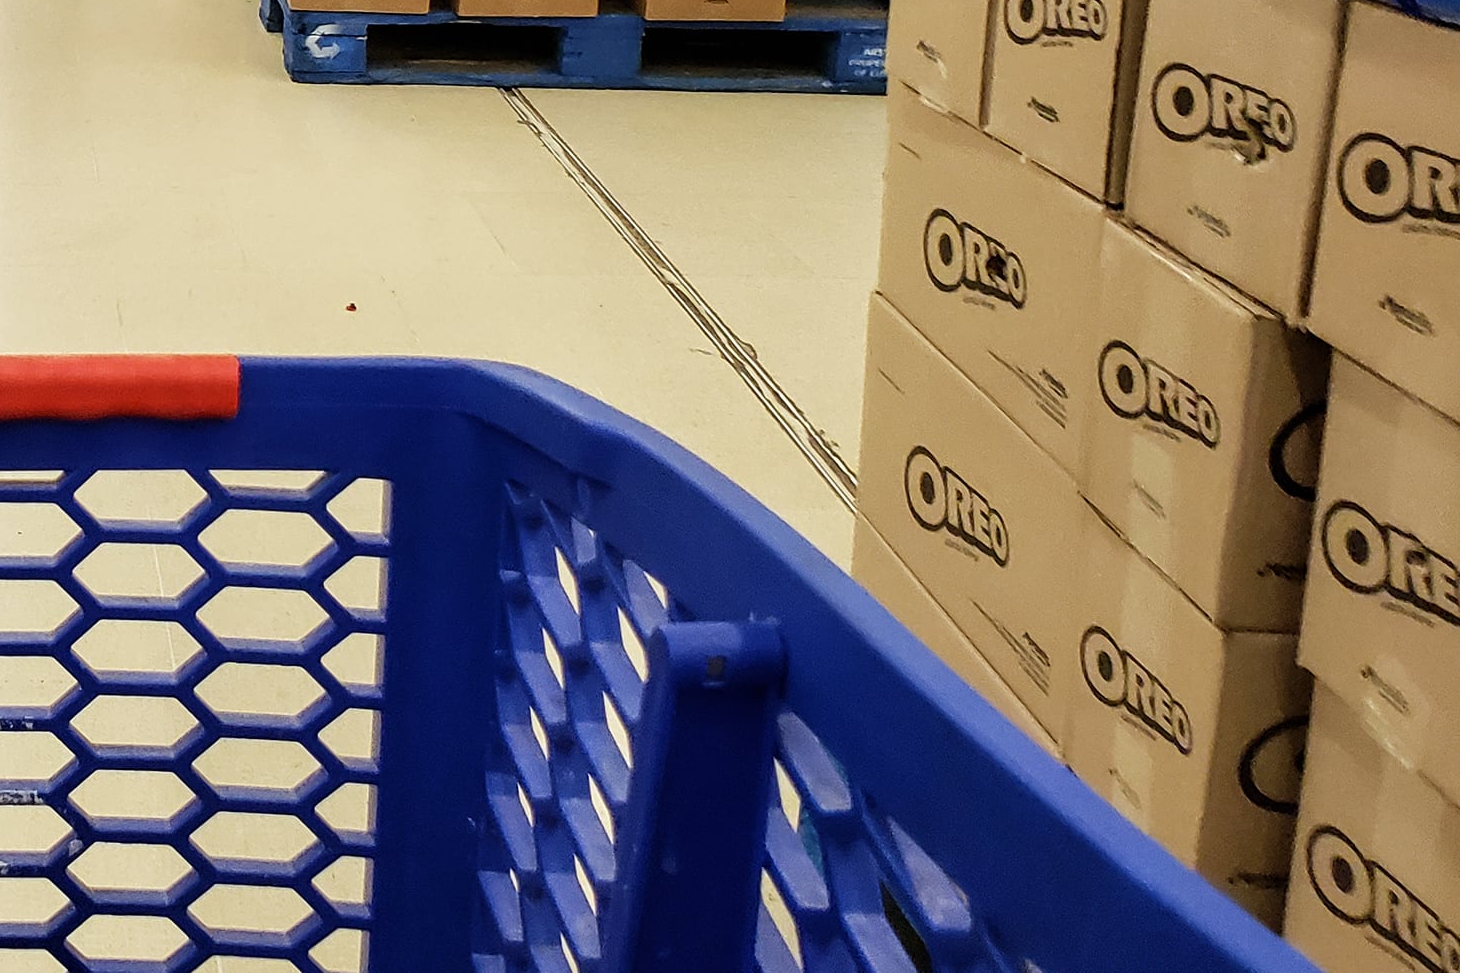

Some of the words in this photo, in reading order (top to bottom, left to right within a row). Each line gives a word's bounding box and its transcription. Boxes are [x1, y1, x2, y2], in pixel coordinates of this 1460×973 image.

[1151, 62, 1297, 152] OREO
[1097, 339, 1221, 450] OREO
[904, 444, 1010, 568] OREO
[1080, 625, 1194, 755] OREO
